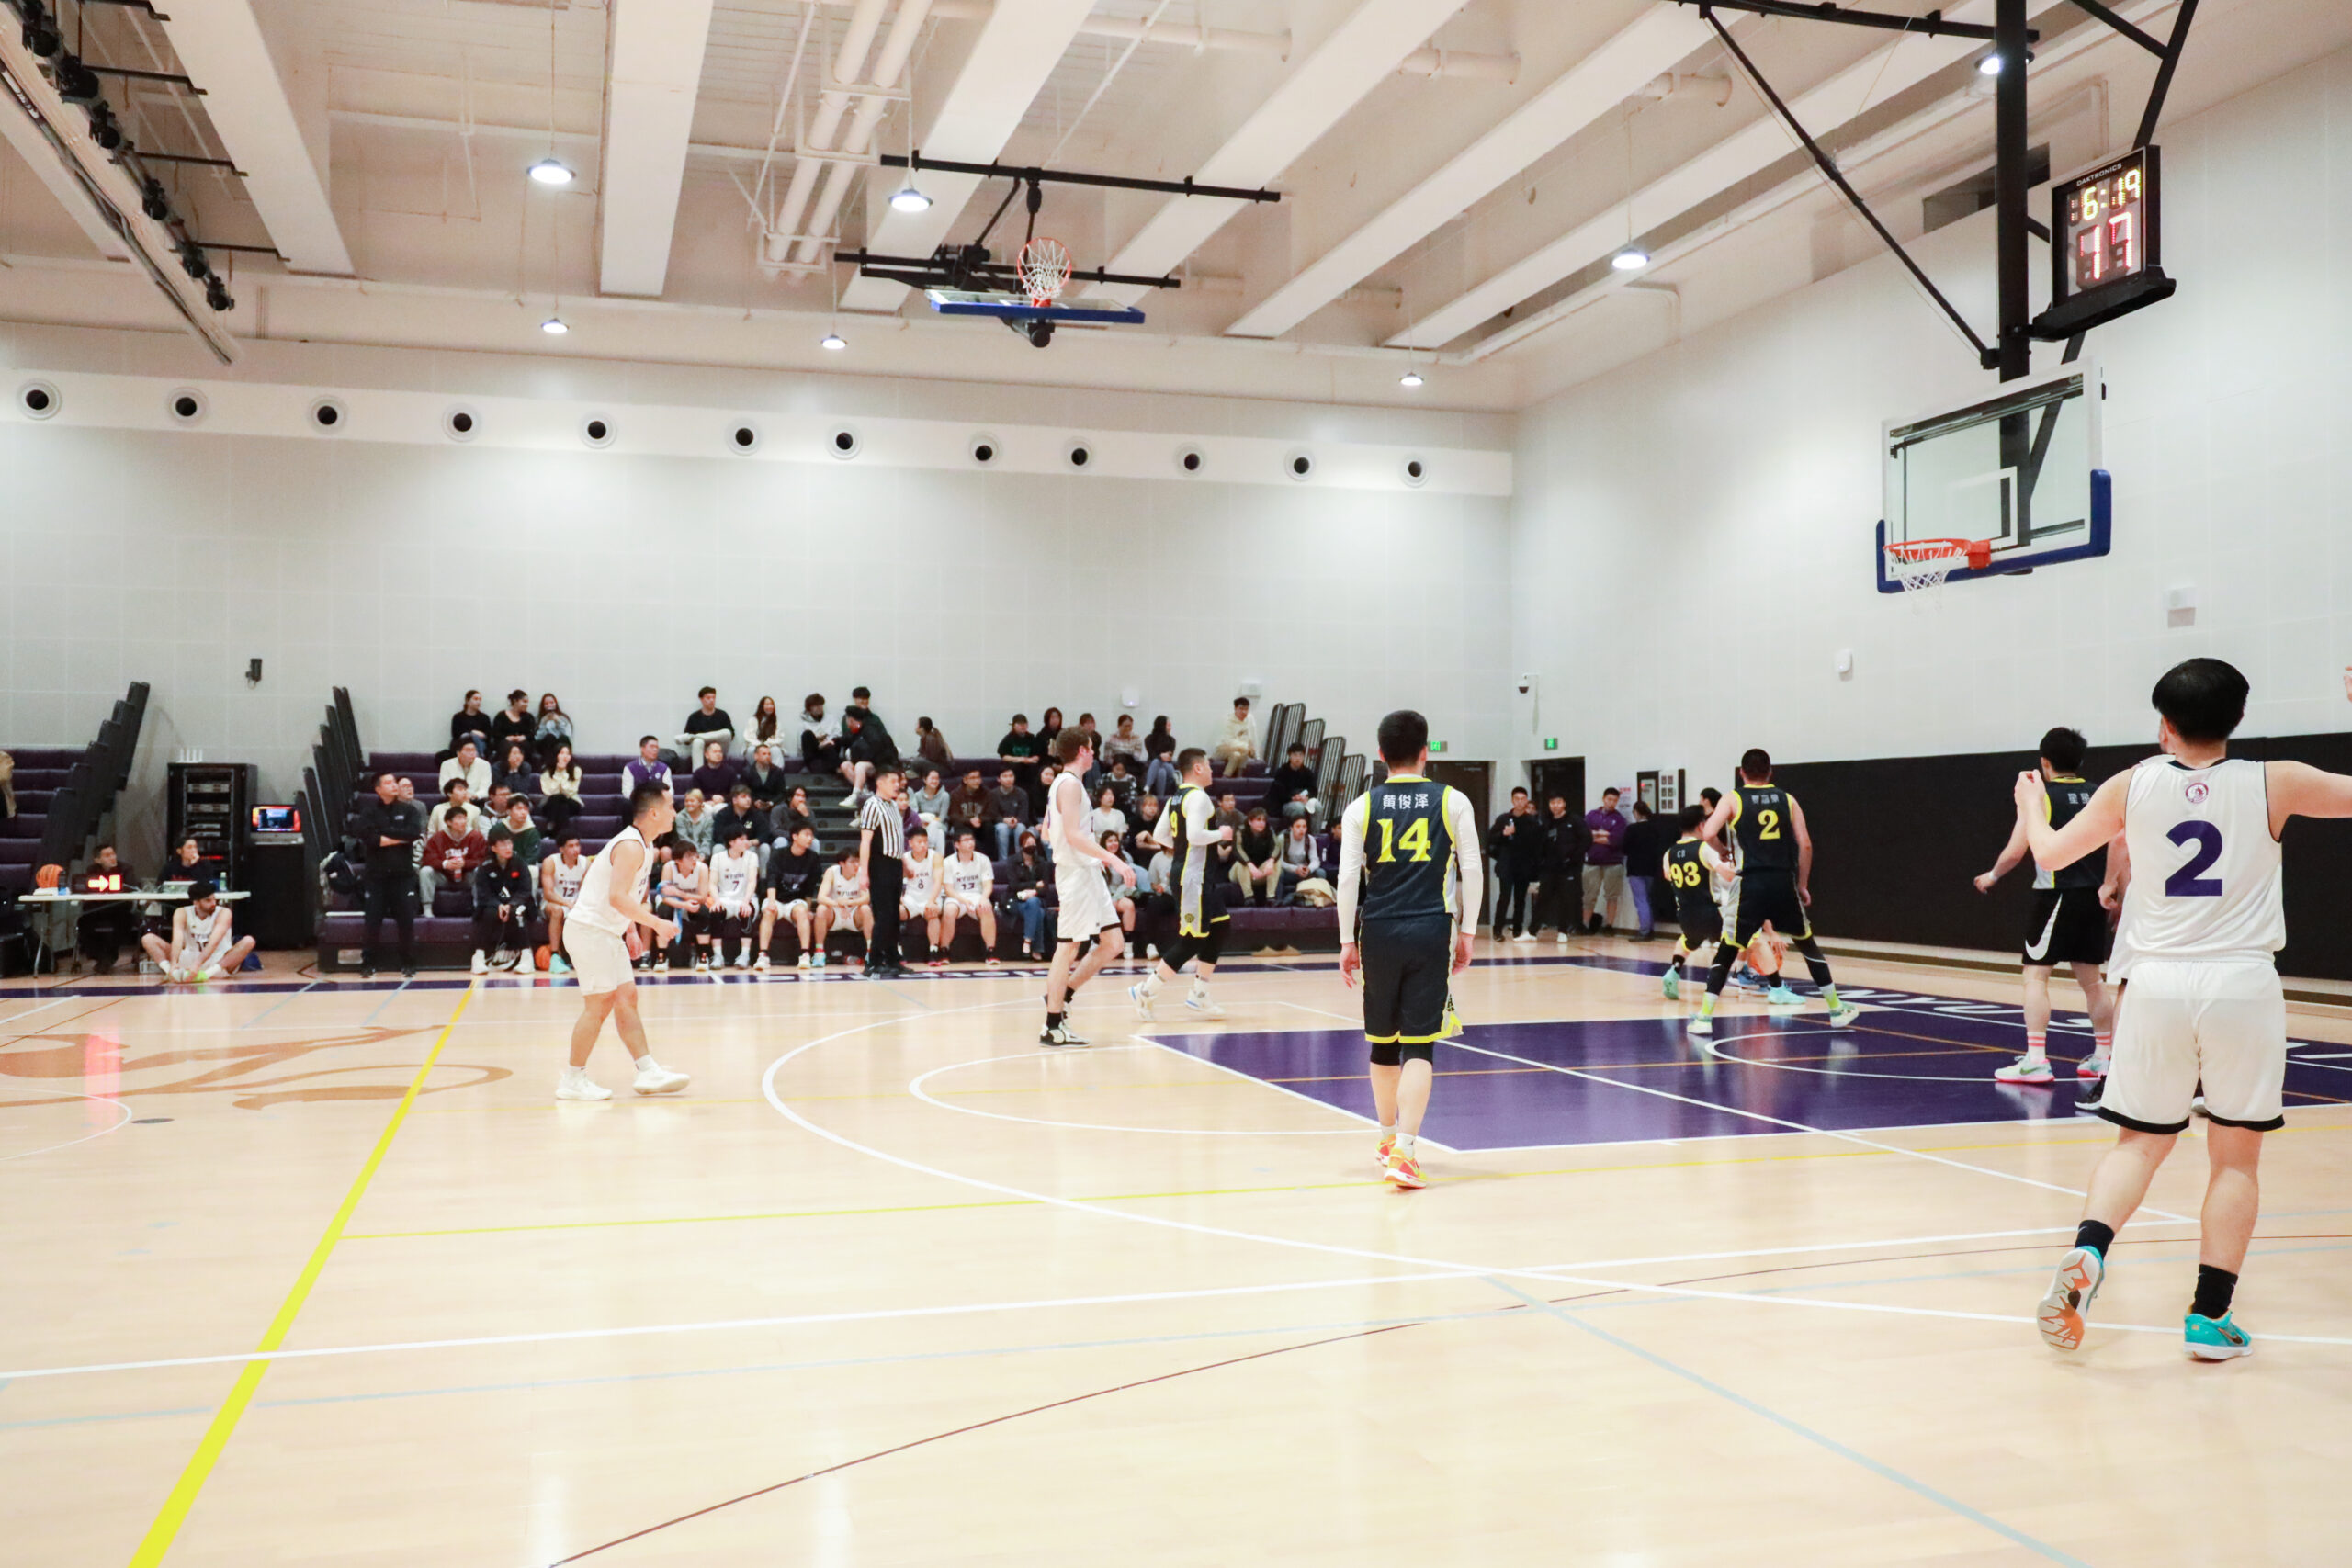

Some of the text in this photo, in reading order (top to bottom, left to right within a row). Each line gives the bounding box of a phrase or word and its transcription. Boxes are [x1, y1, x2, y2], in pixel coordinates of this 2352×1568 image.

[2076, 163, 2122, 186] DAKTRONICS
[2083, 169, 2141, 220] 6:19
[1382, 793, 1430, 810] 黄俊泽
[1758, 809, 1781, 840] 2
[1376, 818, 1432, 863] 14
[2165, 819, 2223, 897] 2
[732, 880, 740, 891] 7
[1670, 861, 1702, 889] 93
[562, 886, 575, 897] 12
